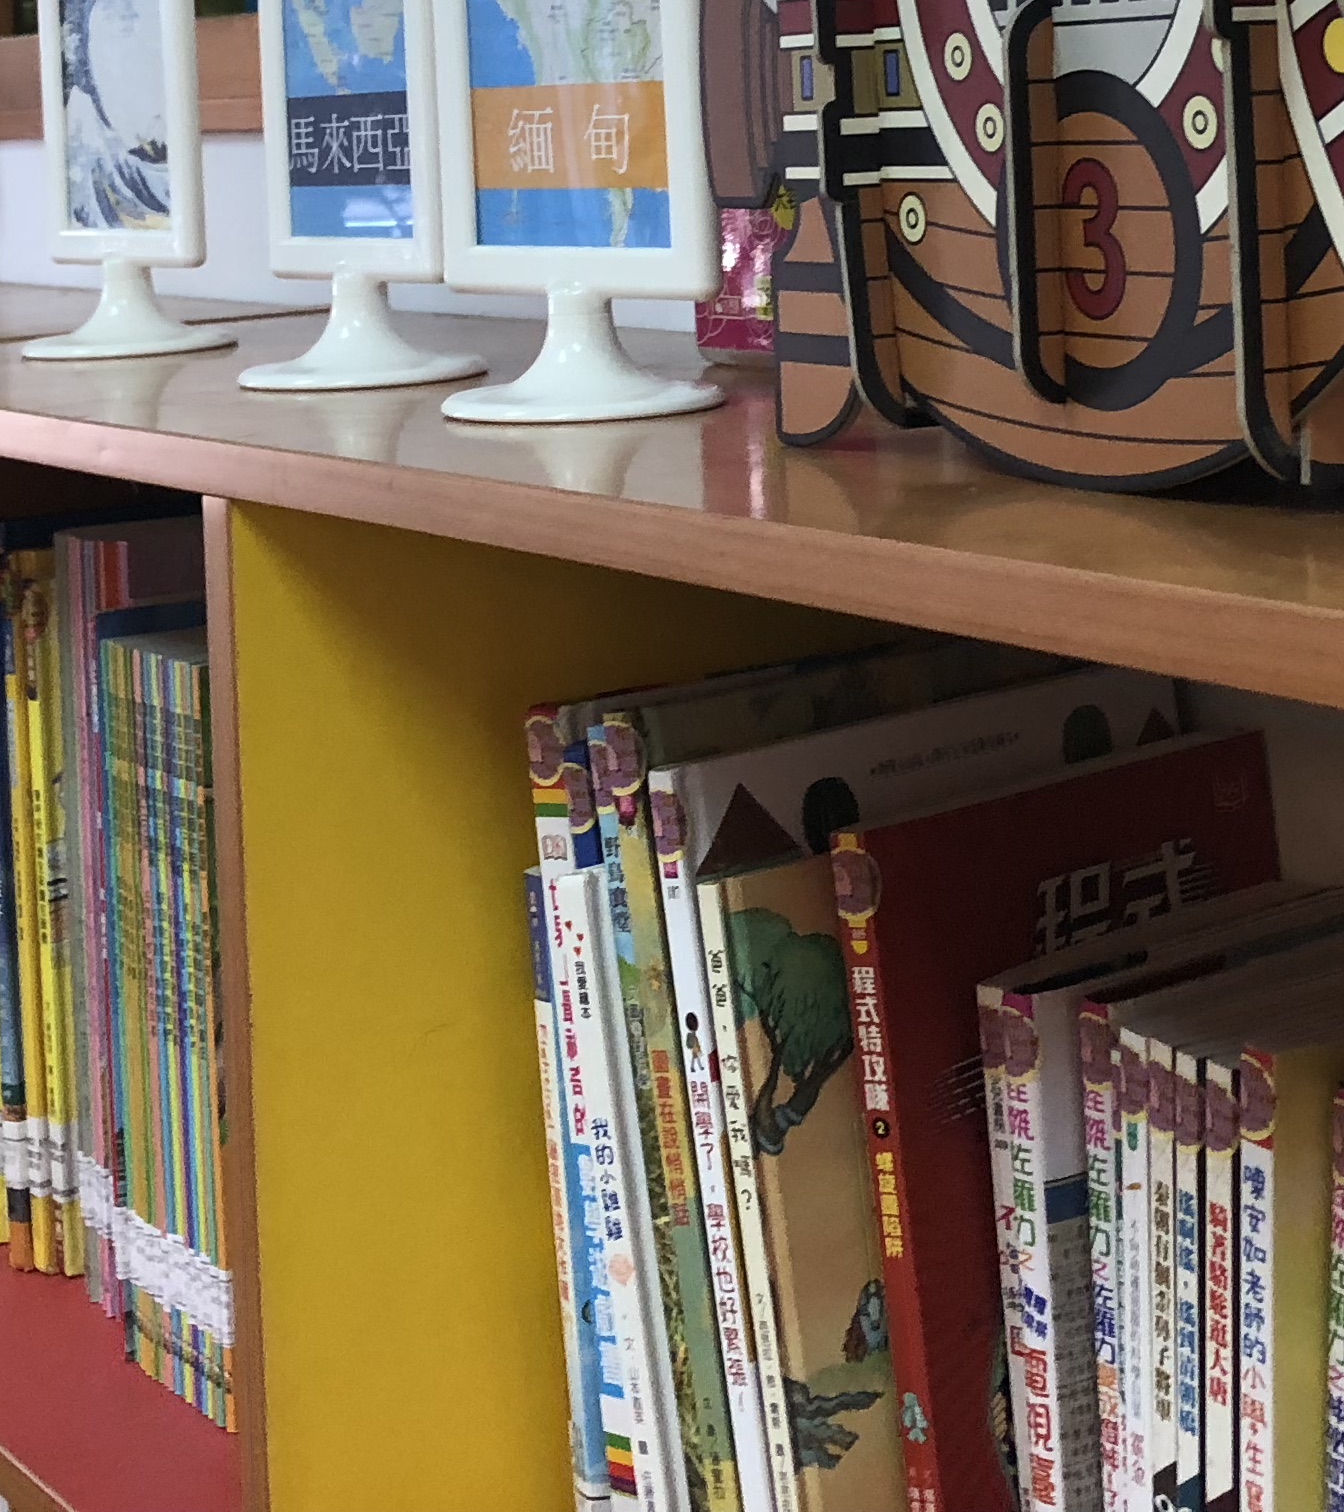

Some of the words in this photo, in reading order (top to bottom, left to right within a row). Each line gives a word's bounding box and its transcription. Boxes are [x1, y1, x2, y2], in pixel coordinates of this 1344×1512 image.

[289, 112, 410, 174] 馬來西亞
[507, 102, 632, 175] 緬甸
[1060, 156, 1126, 322] 3
[851, 965, 891, 1112] 程式特攻隊
